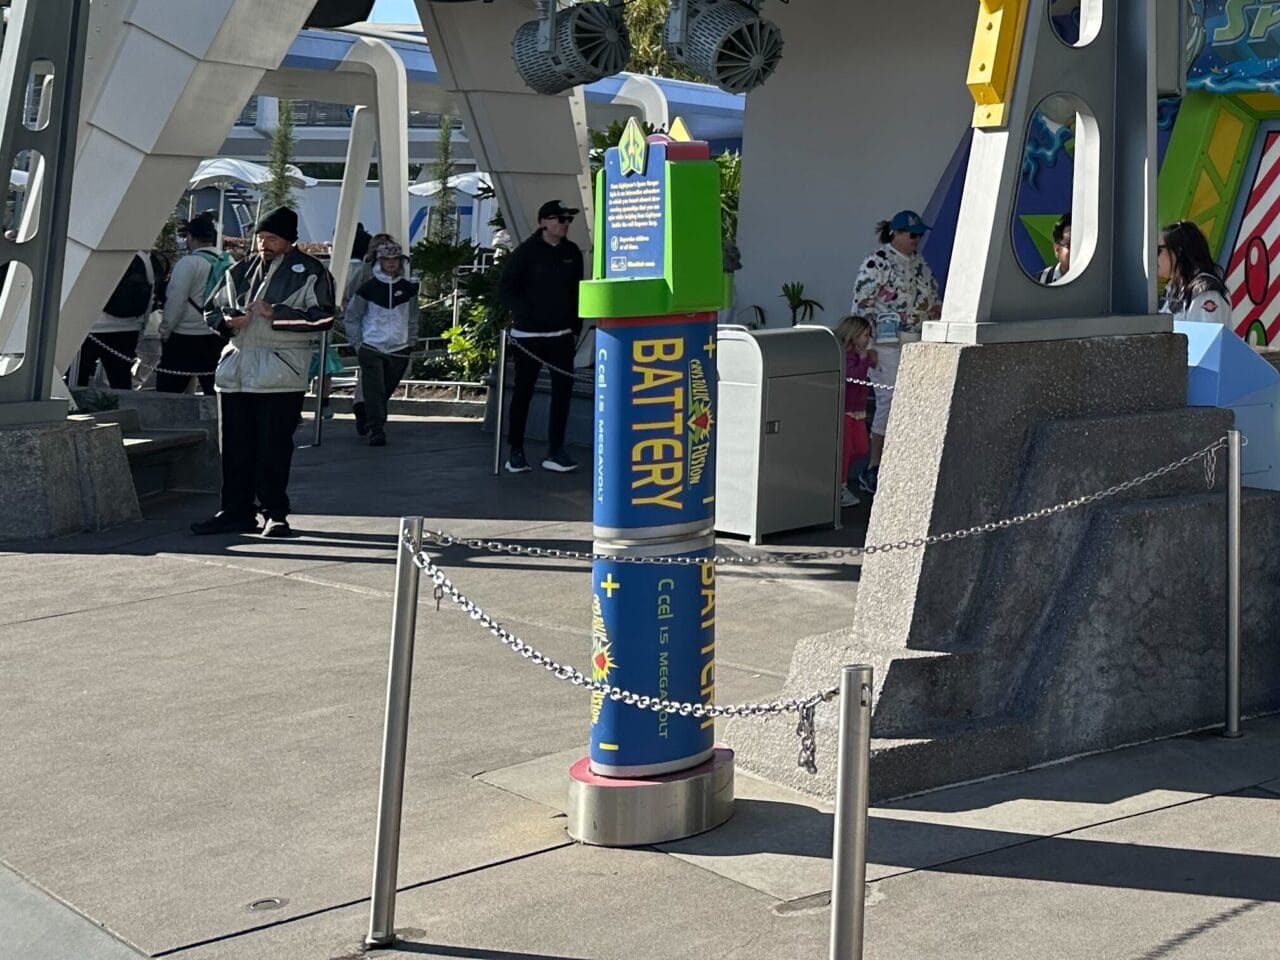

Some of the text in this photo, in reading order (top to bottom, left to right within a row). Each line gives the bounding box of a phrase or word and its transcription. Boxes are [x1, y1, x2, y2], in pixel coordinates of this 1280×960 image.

[597, 419, 605, 505] MEGAVOLT
[631, 337, 684, 510] BATTERY
[689, 441, 710, 485] FUSION
